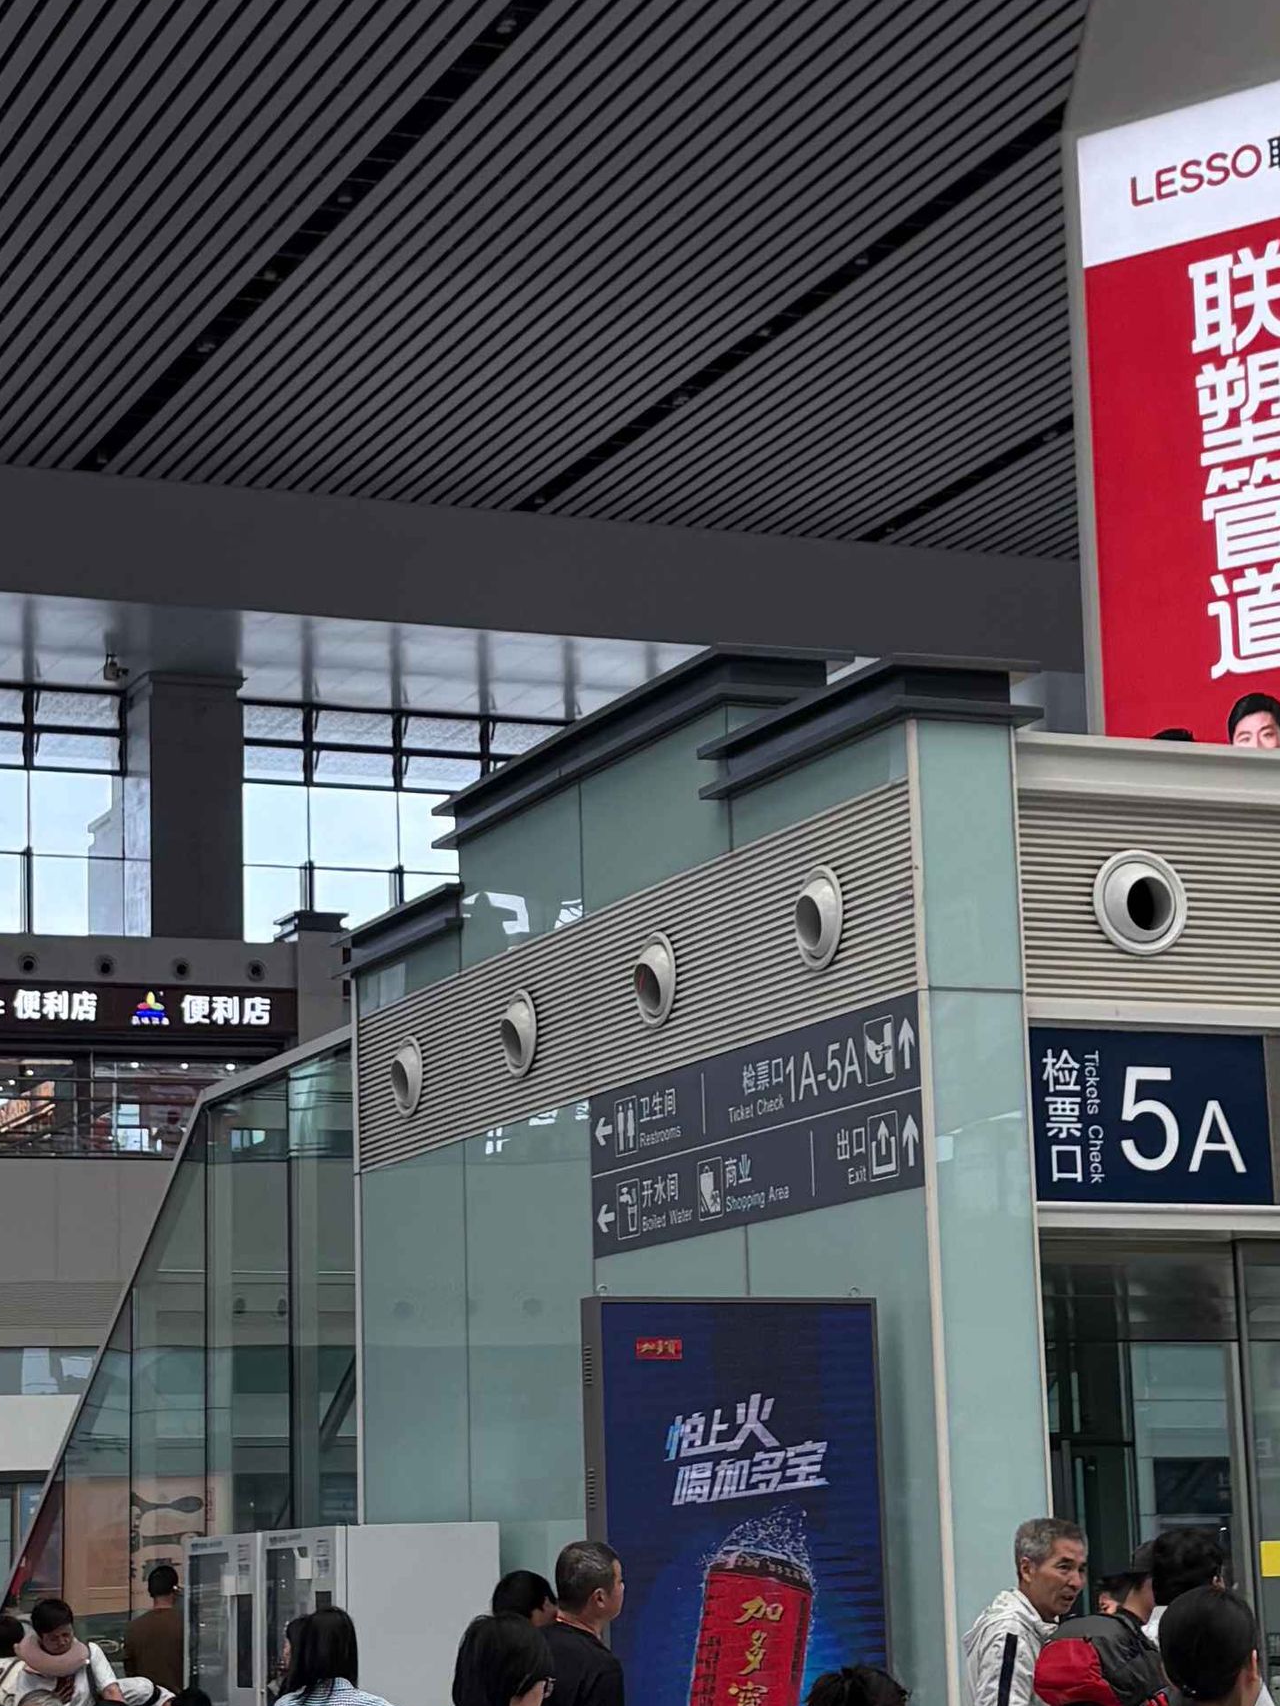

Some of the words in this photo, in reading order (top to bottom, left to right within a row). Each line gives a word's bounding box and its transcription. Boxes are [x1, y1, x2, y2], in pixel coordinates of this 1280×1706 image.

[1130, 143, 1263, 207] LESSO
[14, 989, 98, 1021] 便利店
[181, 994, 271, 1025] 便利店
[742, 1057, 784, 1096] 检票口
[785, 1037, 862, 1102] 1A-5A
[1084, 1050, 1101, 1115] Tickets
[640, 1088, 676, 1122] 卫生间
[728, 1103, 754, 1124] Ticket
[757, 1094, 785, 1115] Check
[1041, 1048, 1083, 1183] 检票口
[1119, 1064, 1248, 1174] 5A
[640, 1125, 682, 1148] Restrooms
[837, 1126, 866, 1160] 出口
[724, 1154, 752, 1189] 商业
[1087, 1125, 1105, 1184] Check
[642, 1173, 679, 1208] 开水间
[848, 1165, 867, 1185] Exit
[725, 1190, 765, 1212] Shopping
[769, 1185, 790, 1201] Area
[642, 1211, 666, 1233] Boiled
[669, 1207, 693, 1225] Water
[664, 1393, 781, 1462] 怕上火
[672, 1440, 830, 1506] 喝加多宝
